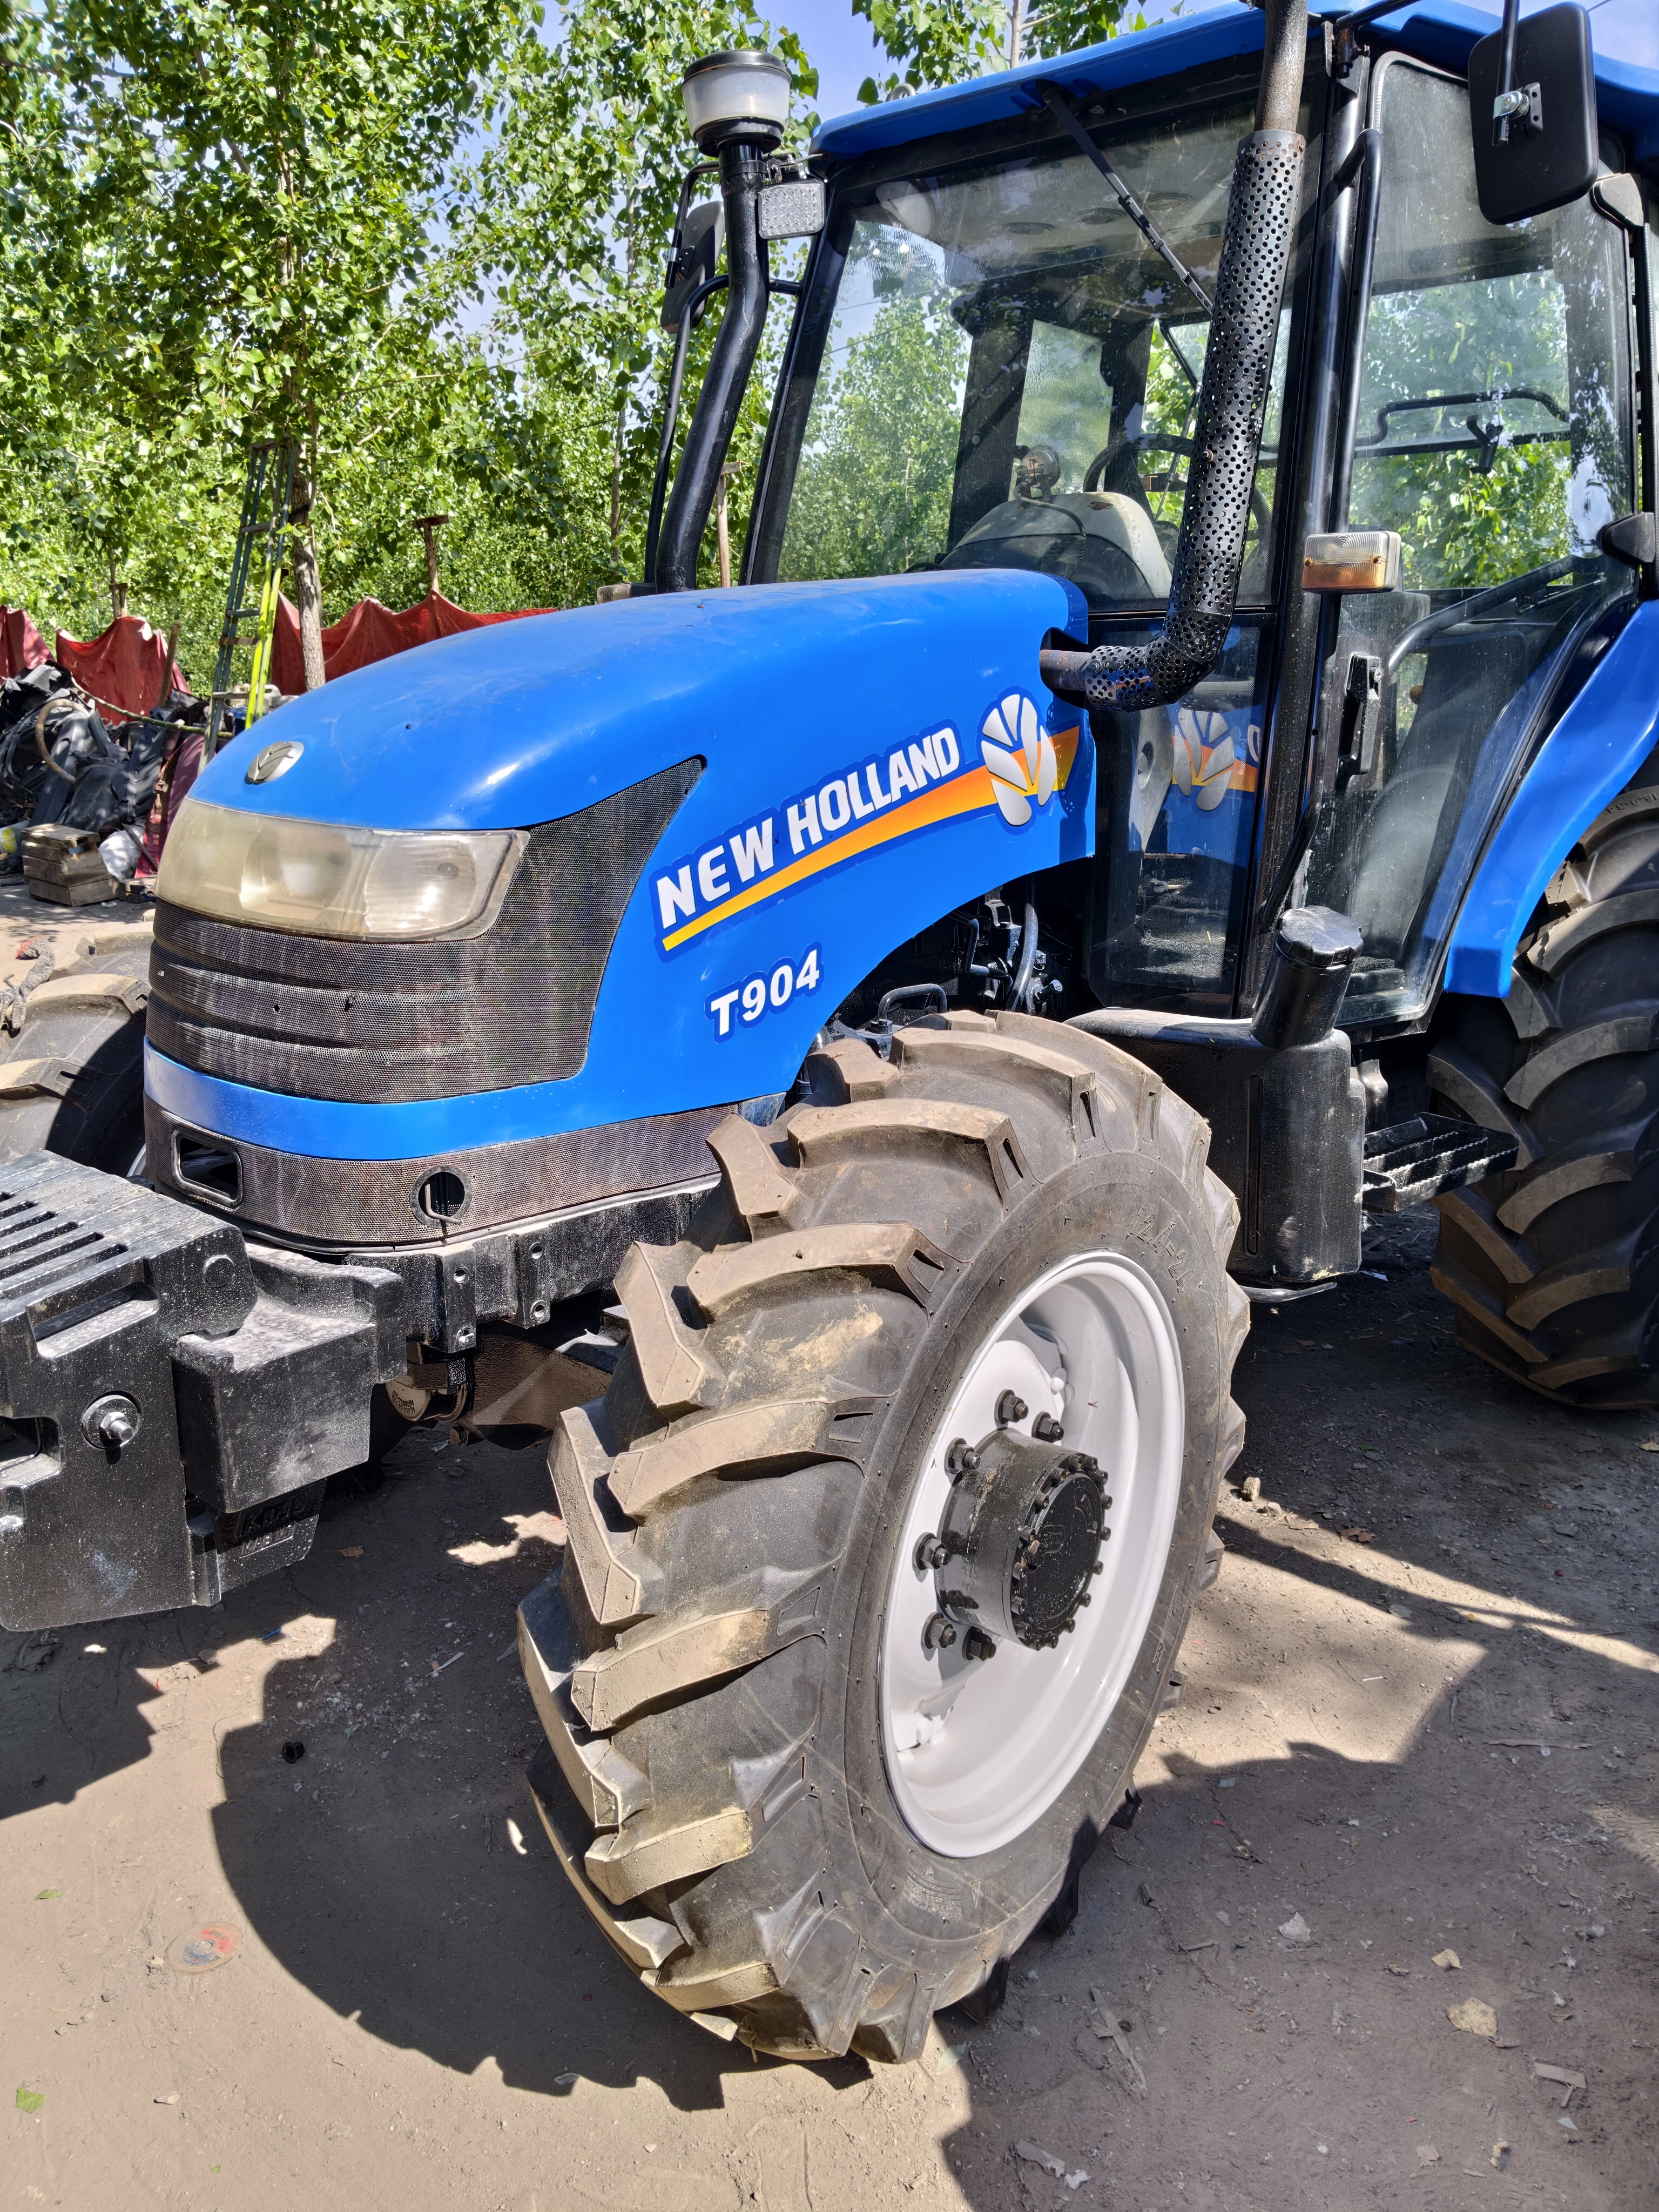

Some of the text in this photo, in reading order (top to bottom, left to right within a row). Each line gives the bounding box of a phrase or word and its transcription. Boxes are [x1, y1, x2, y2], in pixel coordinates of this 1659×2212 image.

[656, 727, 960, 929] NEW HOLLAND
[710, 949, 820, 1037] T904
[1129, 1208, 1195, 1293] 12.4-24
